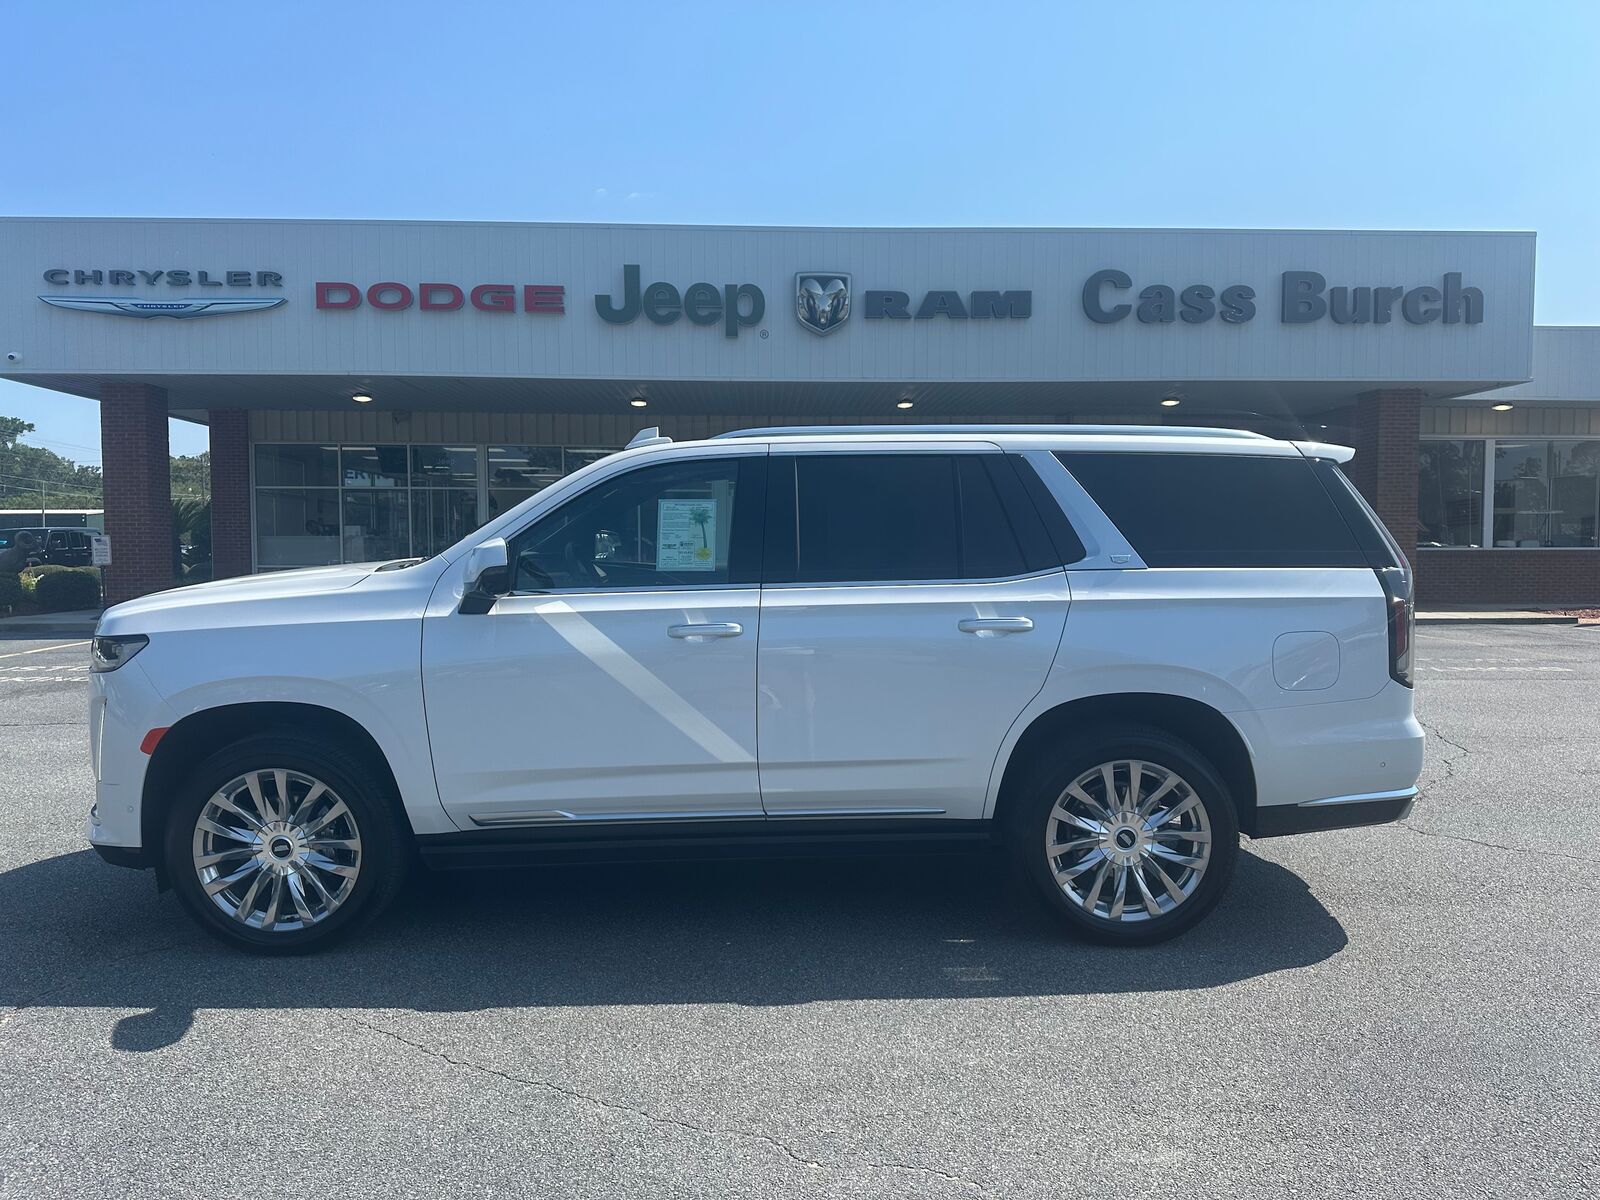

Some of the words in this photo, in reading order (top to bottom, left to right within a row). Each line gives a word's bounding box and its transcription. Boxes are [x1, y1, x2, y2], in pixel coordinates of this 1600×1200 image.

[43, 269, 283, 287] CHRYSLER
[315, 281, 566, 314] DODGE
[595, 264, 765, 337] Jeep
[864, 290, 1032, 319] RAM
[1082, 269, 1255, 325] Cass
[1281, 270, 1484, 325] Burch
